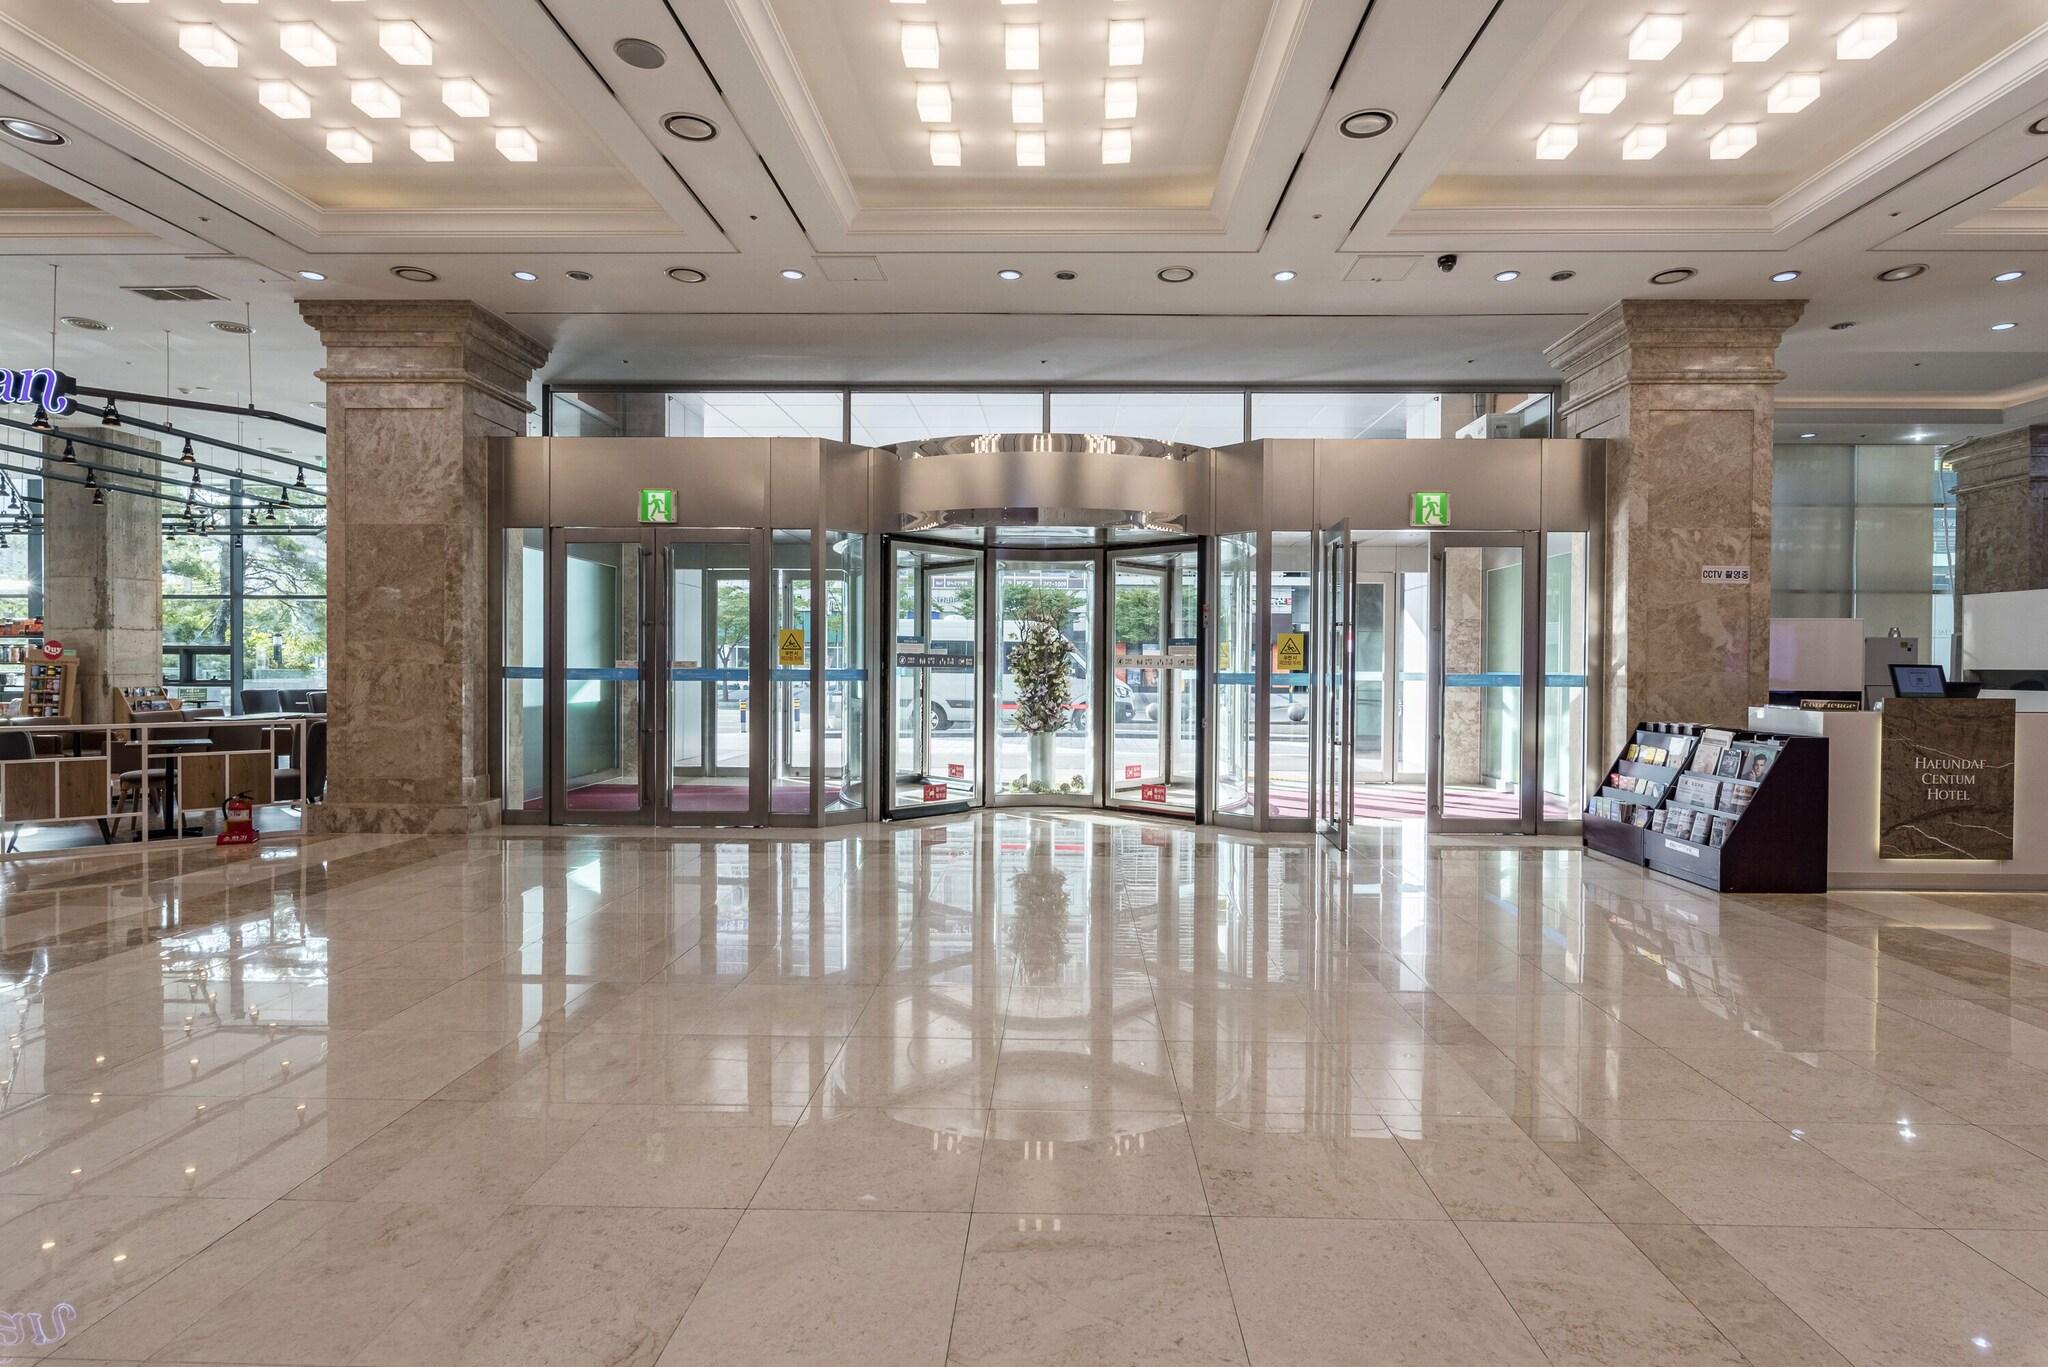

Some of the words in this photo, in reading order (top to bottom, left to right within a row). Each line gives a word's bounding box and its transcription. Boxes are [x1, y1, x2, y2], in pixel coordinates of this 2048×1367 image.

[1702, 570, 1723, 579] CCTV
[1915, 757, 1987, 770] HAEUNDAE
[1921, 772, 1976, 785] CENTUM
[1927, 788, 1971, 801] HOTEL
